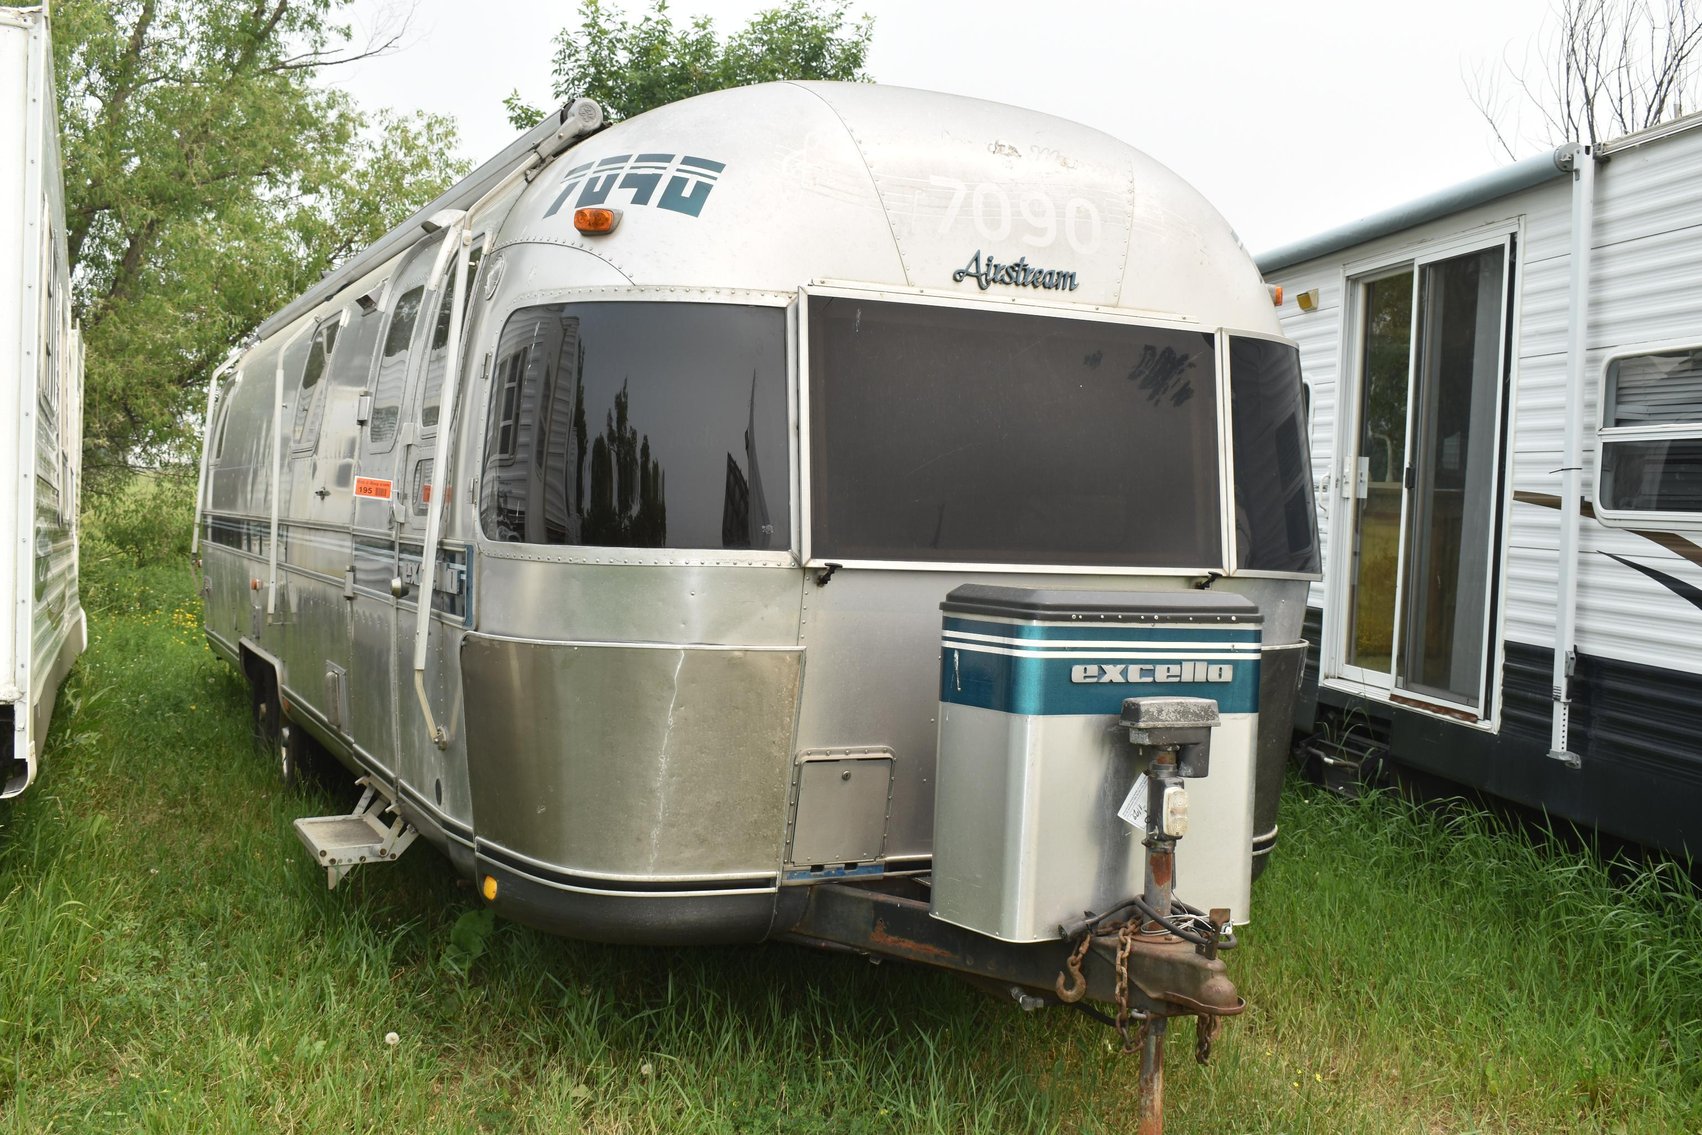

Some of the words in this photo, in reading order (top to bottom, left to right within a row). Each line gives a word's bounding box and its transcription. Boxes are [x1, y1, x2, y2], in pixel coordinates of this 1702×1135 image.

[542, 153, 727, 219] 7090
[930, 175, 1102, 255] 7090
[953, 249, 1079, 291] Airstream
[359, 486, 373, 494] 195
[1071, 661, 1233, 683] excello
